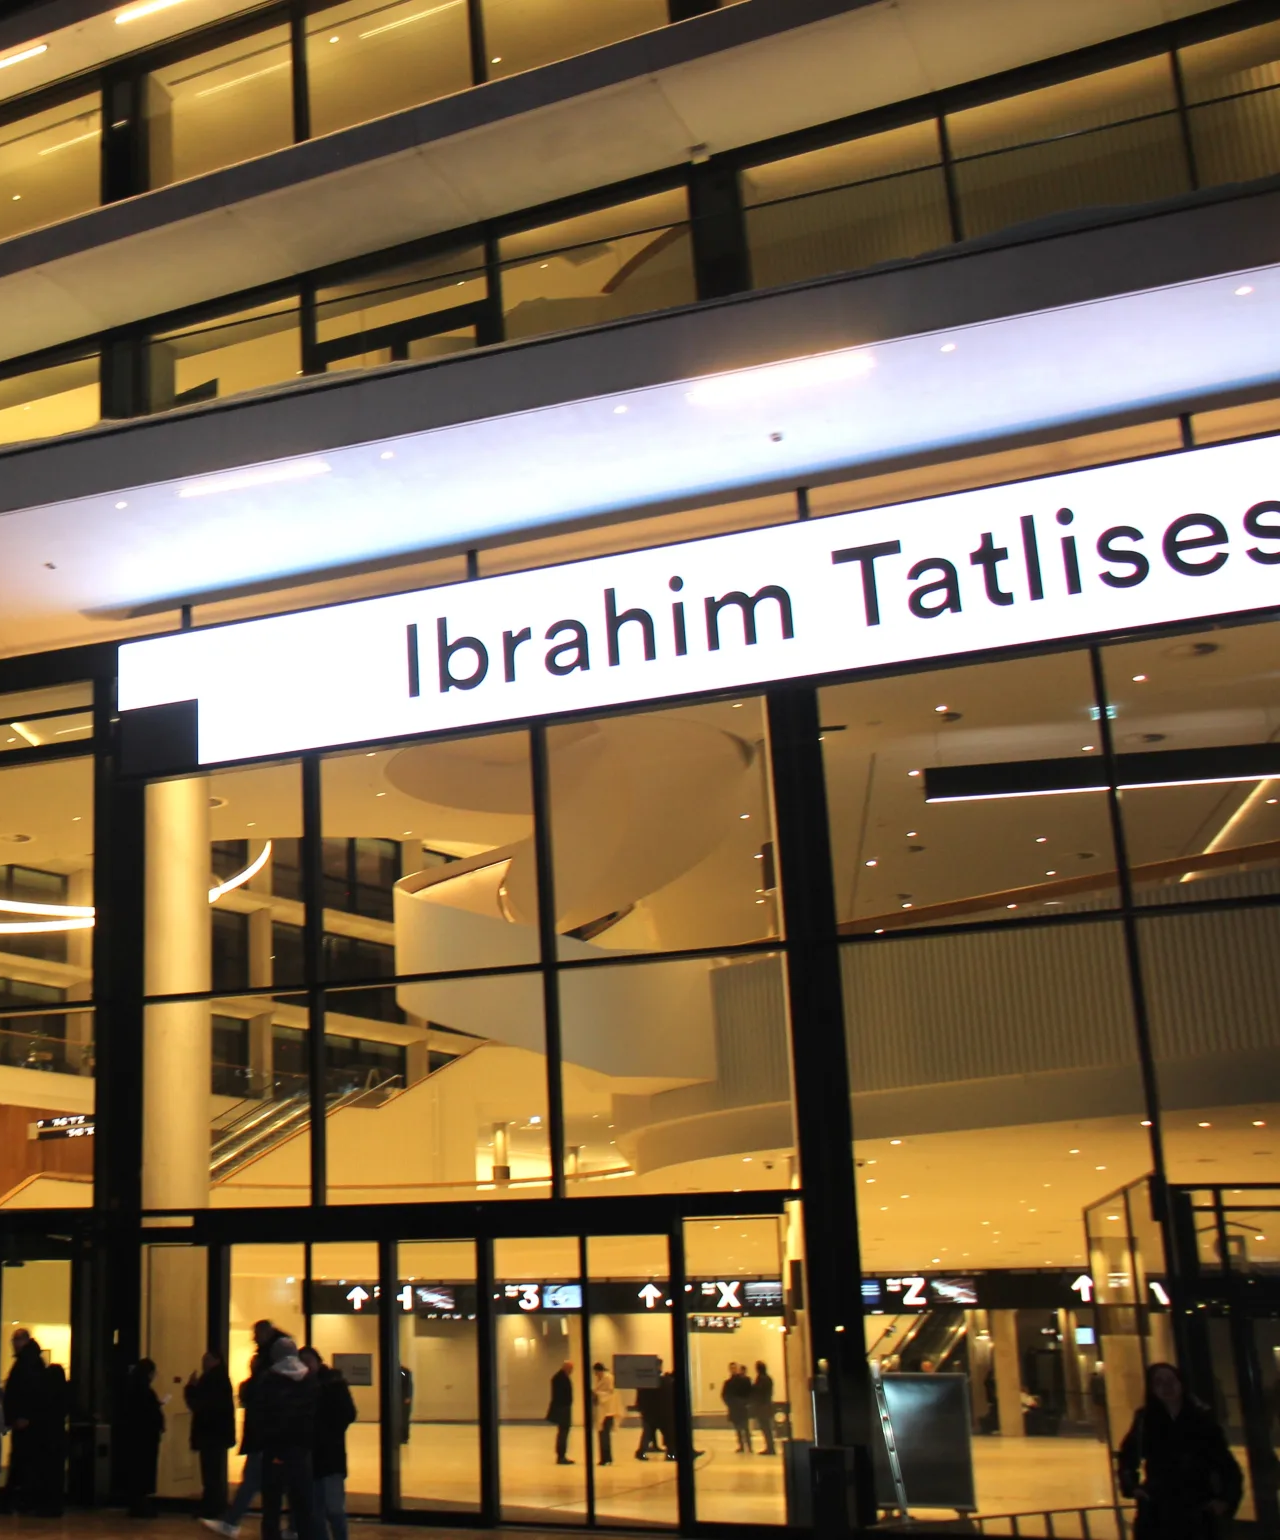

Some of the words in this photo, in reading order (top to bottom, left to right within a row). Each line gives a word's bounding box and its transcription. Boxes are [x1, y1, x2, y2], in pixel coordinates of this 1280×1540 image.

[407, 575, 795, 698] Ibrahim
[518, 1284, 540, 1311] 3
[716, 1281, 742, 1308] X
[901, 1277, 927, 1305] Z
